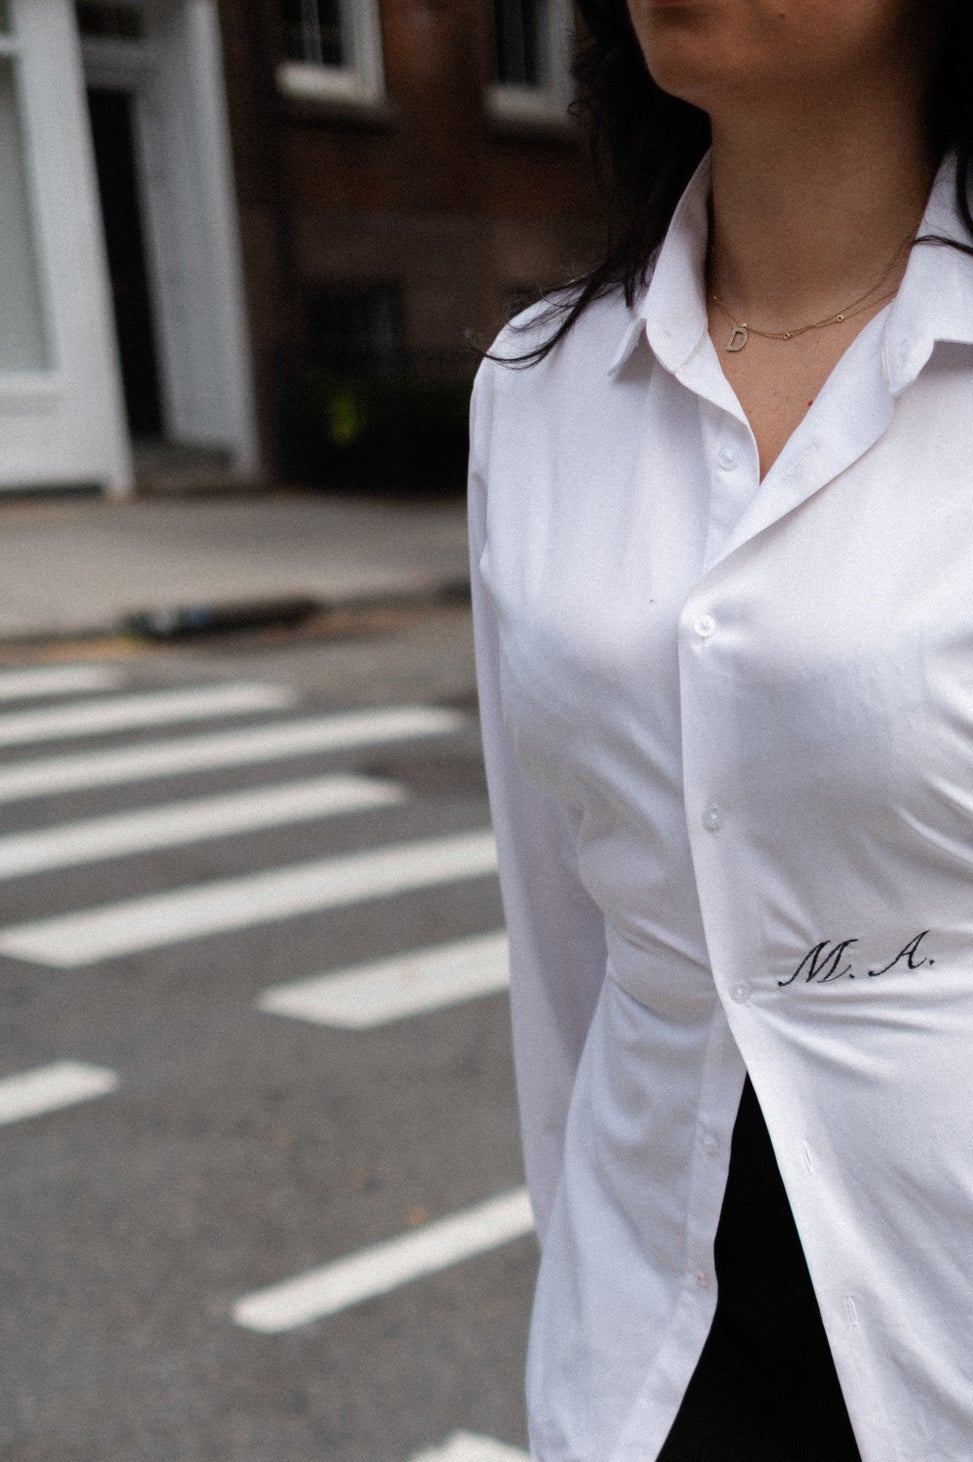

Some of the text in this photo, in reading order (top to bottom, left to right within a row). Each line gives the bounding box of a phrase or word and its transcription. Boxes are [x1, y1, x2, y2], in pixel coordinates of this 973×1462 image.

[726, 326, 748, 352] D
[778, 929, 935, 987] M. A.
